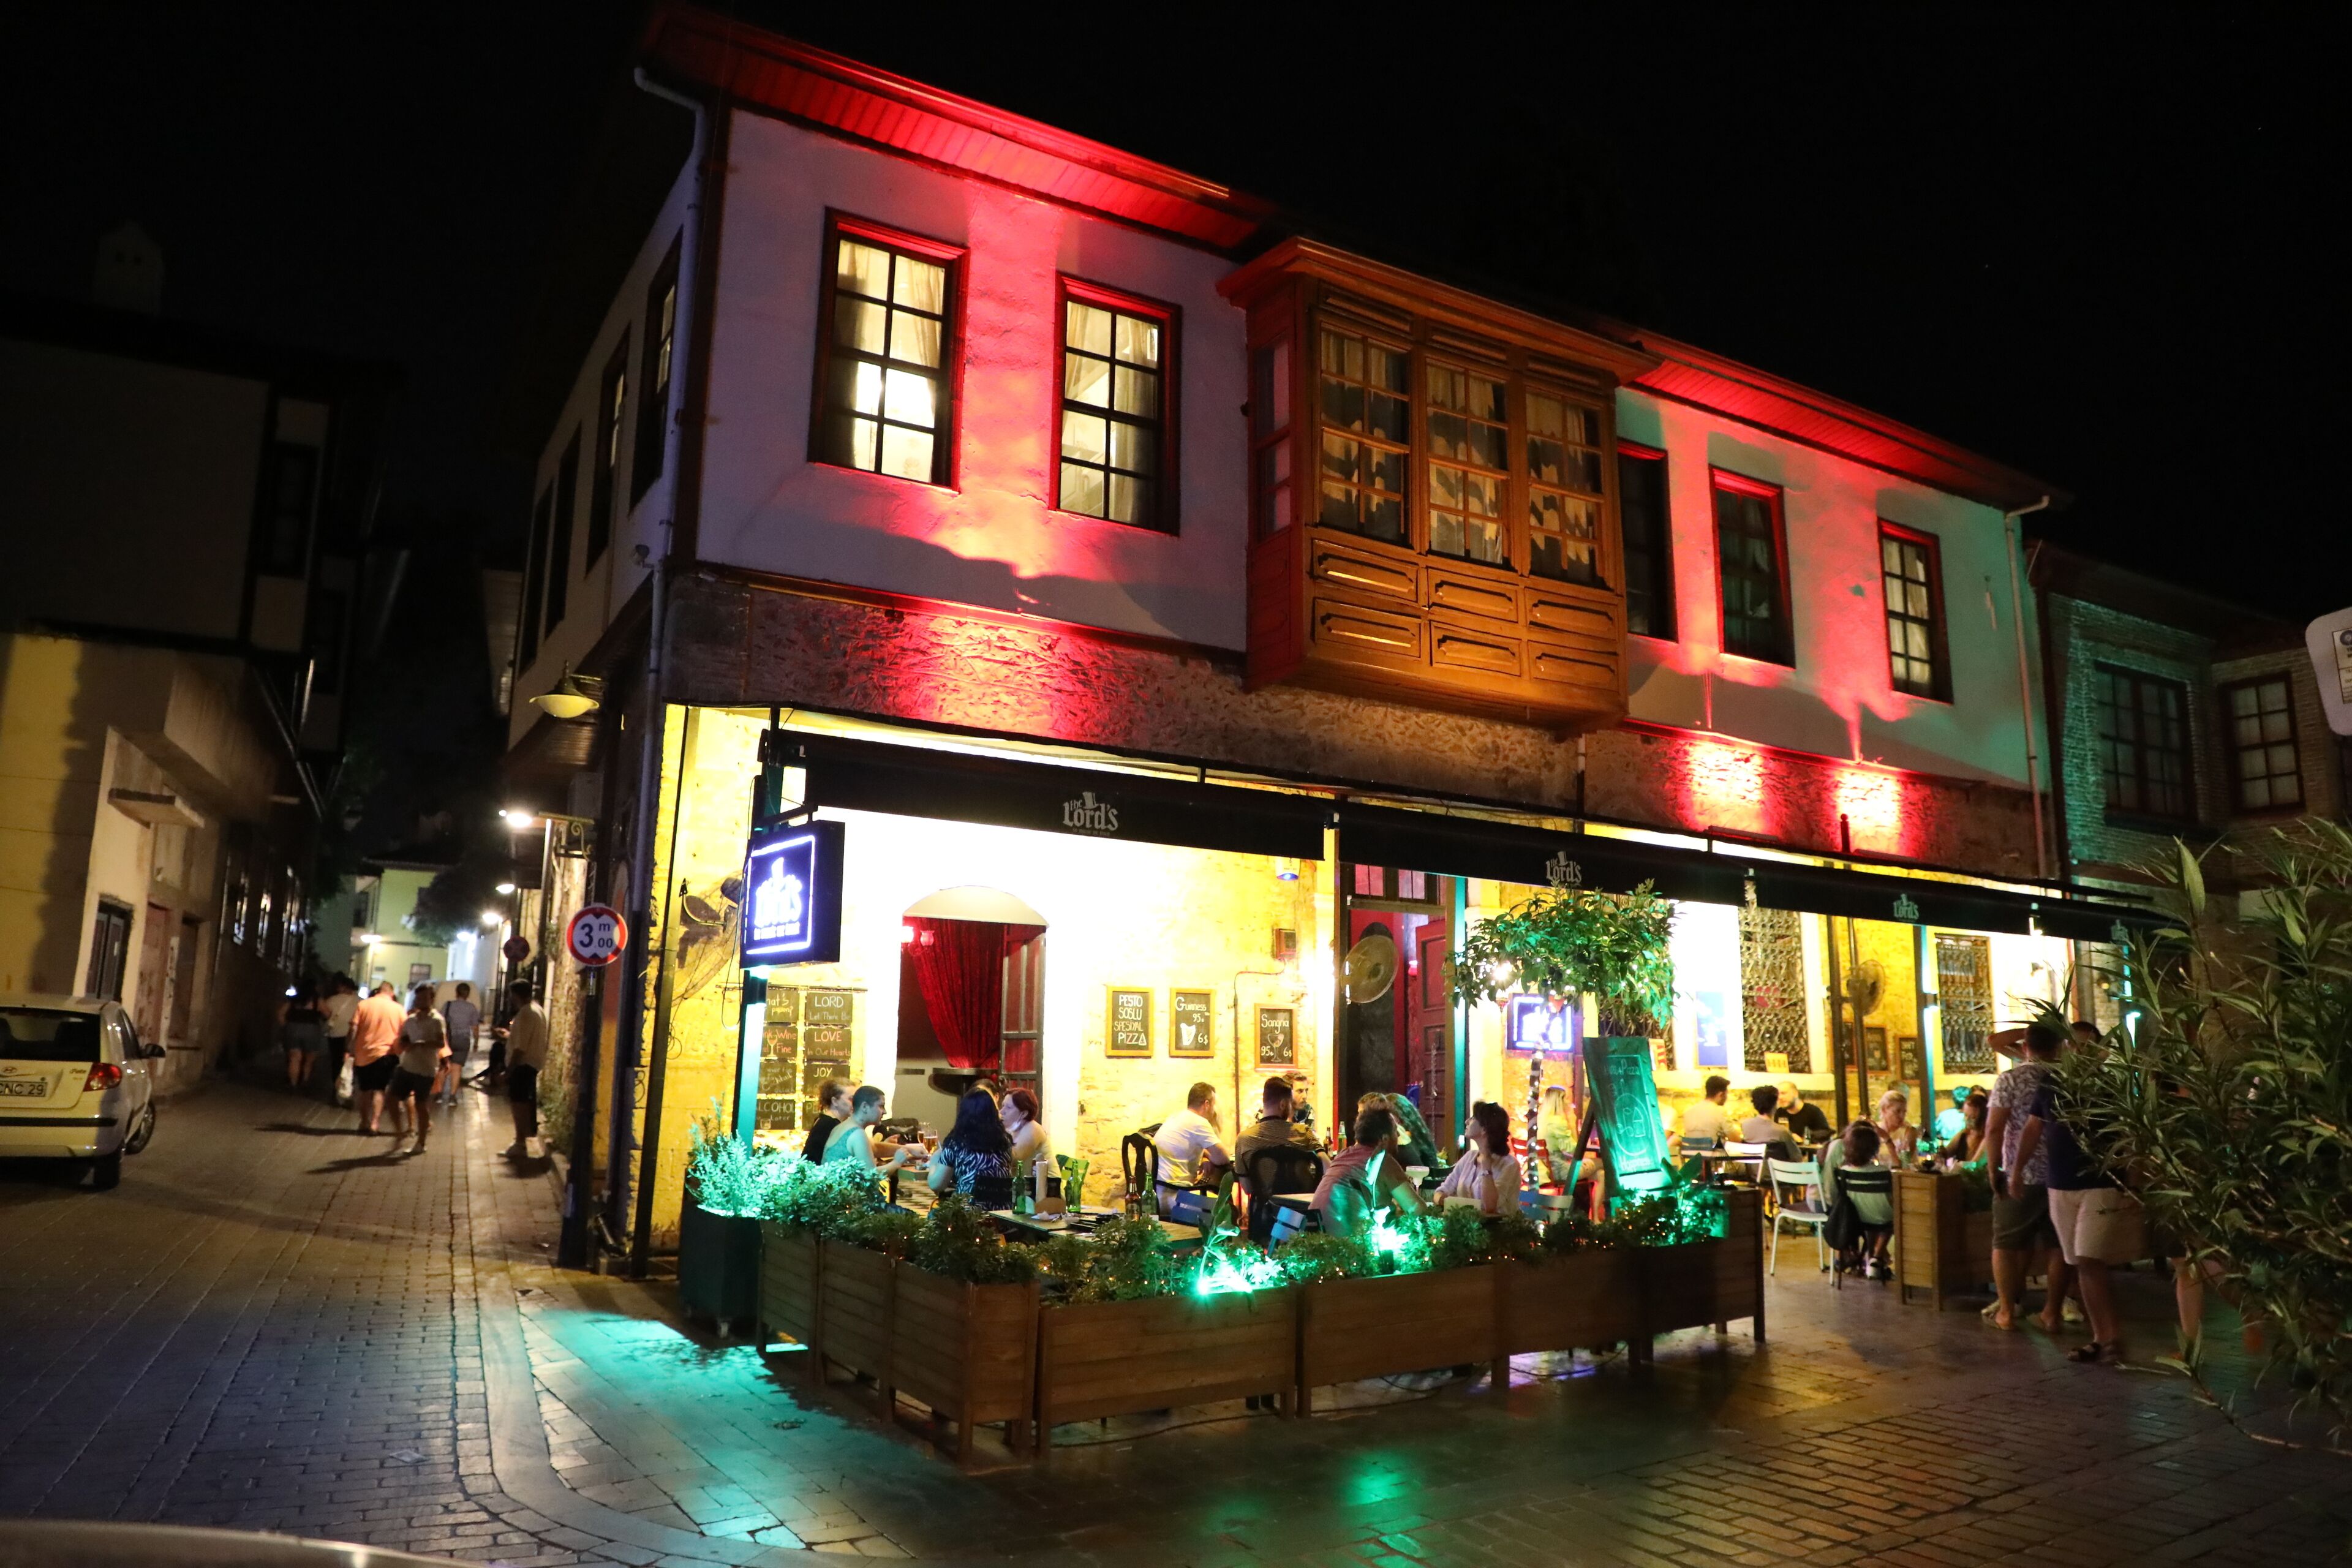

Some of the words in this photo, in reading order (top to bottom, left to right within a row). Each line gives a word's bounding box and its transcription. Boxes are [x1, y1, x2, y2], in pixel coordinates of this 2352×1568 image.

[1069, 799, 1083, 812] the
[1063, 801, 1118, 831] Lord's
[1545, 860, 1582, 883] Lord's
[599, 922, 611, 932] m
[579, 923, 594, 948] 3
[815, 996, 844, 1008] LORD
[1118, 994, 1144, 1008] PESTO
[1175, 996, 1207, 1011] Guinness
[809, 1012, 820, 1020] Let
[1118, 1007, 1142, 1020] SOSLU
[1261, 1014, 1289, 1035] Sangria
[776, 1028, 796, 1040] Wine
[814, 1030, 843, 1042] LOVE
[1197, 1033, 1208, 1046] 6$
[776, 1042, 792, 1054] Fine
[830, 1047, 851, 1057] Hearts
[1283, 1046, 1292, 1058] 6$
[813, 1067, 833, 1077] JOY
[28, 1084, 44, 1095] 29
[758, 1101, 795, 1114] LCOHOL
